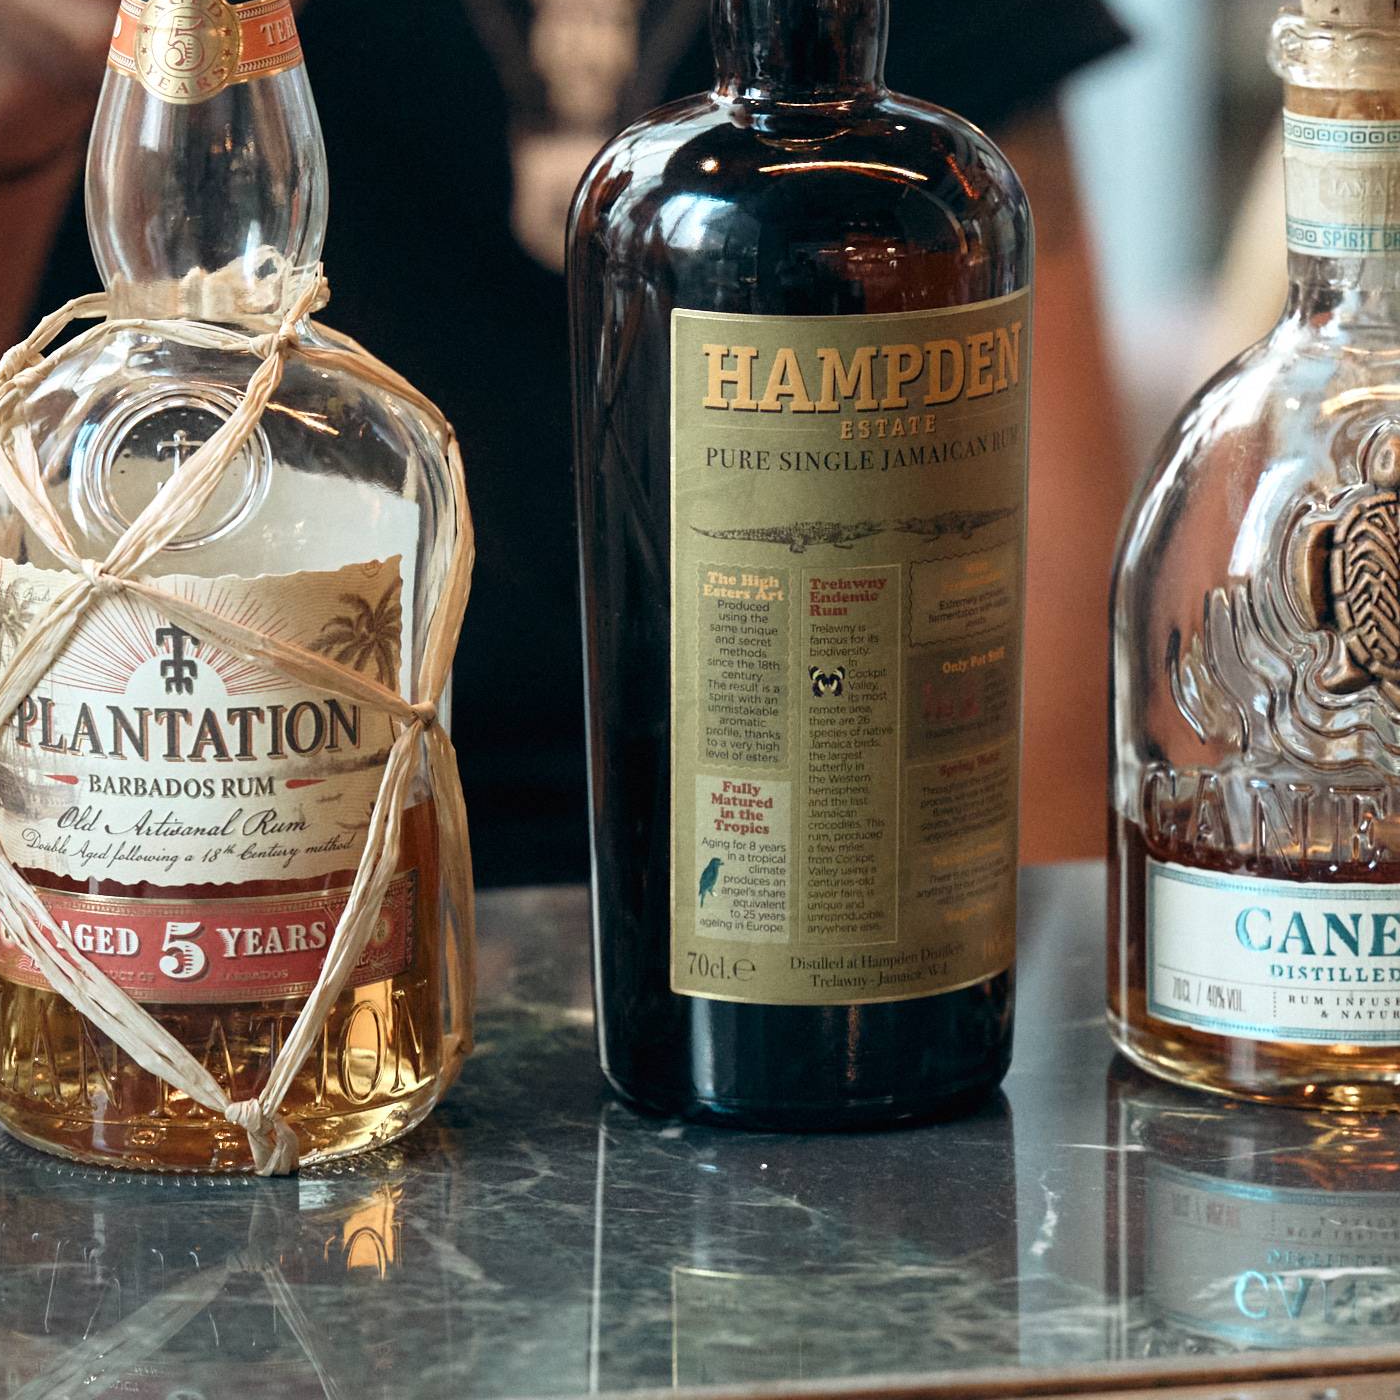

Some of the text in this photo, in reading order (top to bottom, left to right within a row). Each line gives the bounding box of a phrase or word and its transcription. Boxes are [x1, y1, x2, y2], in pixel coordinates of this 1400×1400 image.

[165, 16, 204, 72] 5
[146, 64, 227, 94] YEARS
[1322, 230, 1374, 249] SPIRIT
[702, 320, 1023, 413] HAMPDEN
[840, 414, 937, 440] ESTATE
[706, 447, 771, 471] PURE
[779, 447, 875, 472] SINGLE
[881, 438, 989, 471] JAMAICAN
[708, 571, 779, 589] The High
[809, 577, 887, 591] Trelawny
[703, 584, 784, 601] Esters Art
[810, 590, 879, 603] Endemic
[810, 604, 848, 617] Rum
[15, 695, 361, 762] PLANTATION
[89, 774, 276, 798] BARBADOS RUM
[722, 781, 761, 796] Fully
[711, 792, 773, 809] Matured
[56, 805, 311, 837] Old Artisanal Rum
[720, 808, 764, 821] in the
[714, 819, 770, 835] Tropics
[22, 828, 355, 872] Double Aged following a 18th Century method
[701, 836, 786, 854] Aging for 8 years
[727, 852, 736, 860] in
[748, 853, 786, 865] tropical
[749, 865, 786, 875] climate
[723, 875, 786, 887] produces an
[721, 886, 786, 898] angel's share
[733, 899, 786, 910] equivalent
[730, 909, 786, 922] to 25 years
[699, 918, 785, 933] ageing in Europe.
[57, 919, 140, 957] AGED
[159, 921, 207, 980] 5
[216, 921, 328, 958] YEARS
[790, 953, 918, 970] Distilled at Hampden
[810, 973, 866, 989] Trelawny
[1288, 995, 1323, 1006] RUM
[1320, 1011, 1328, 1019] &
